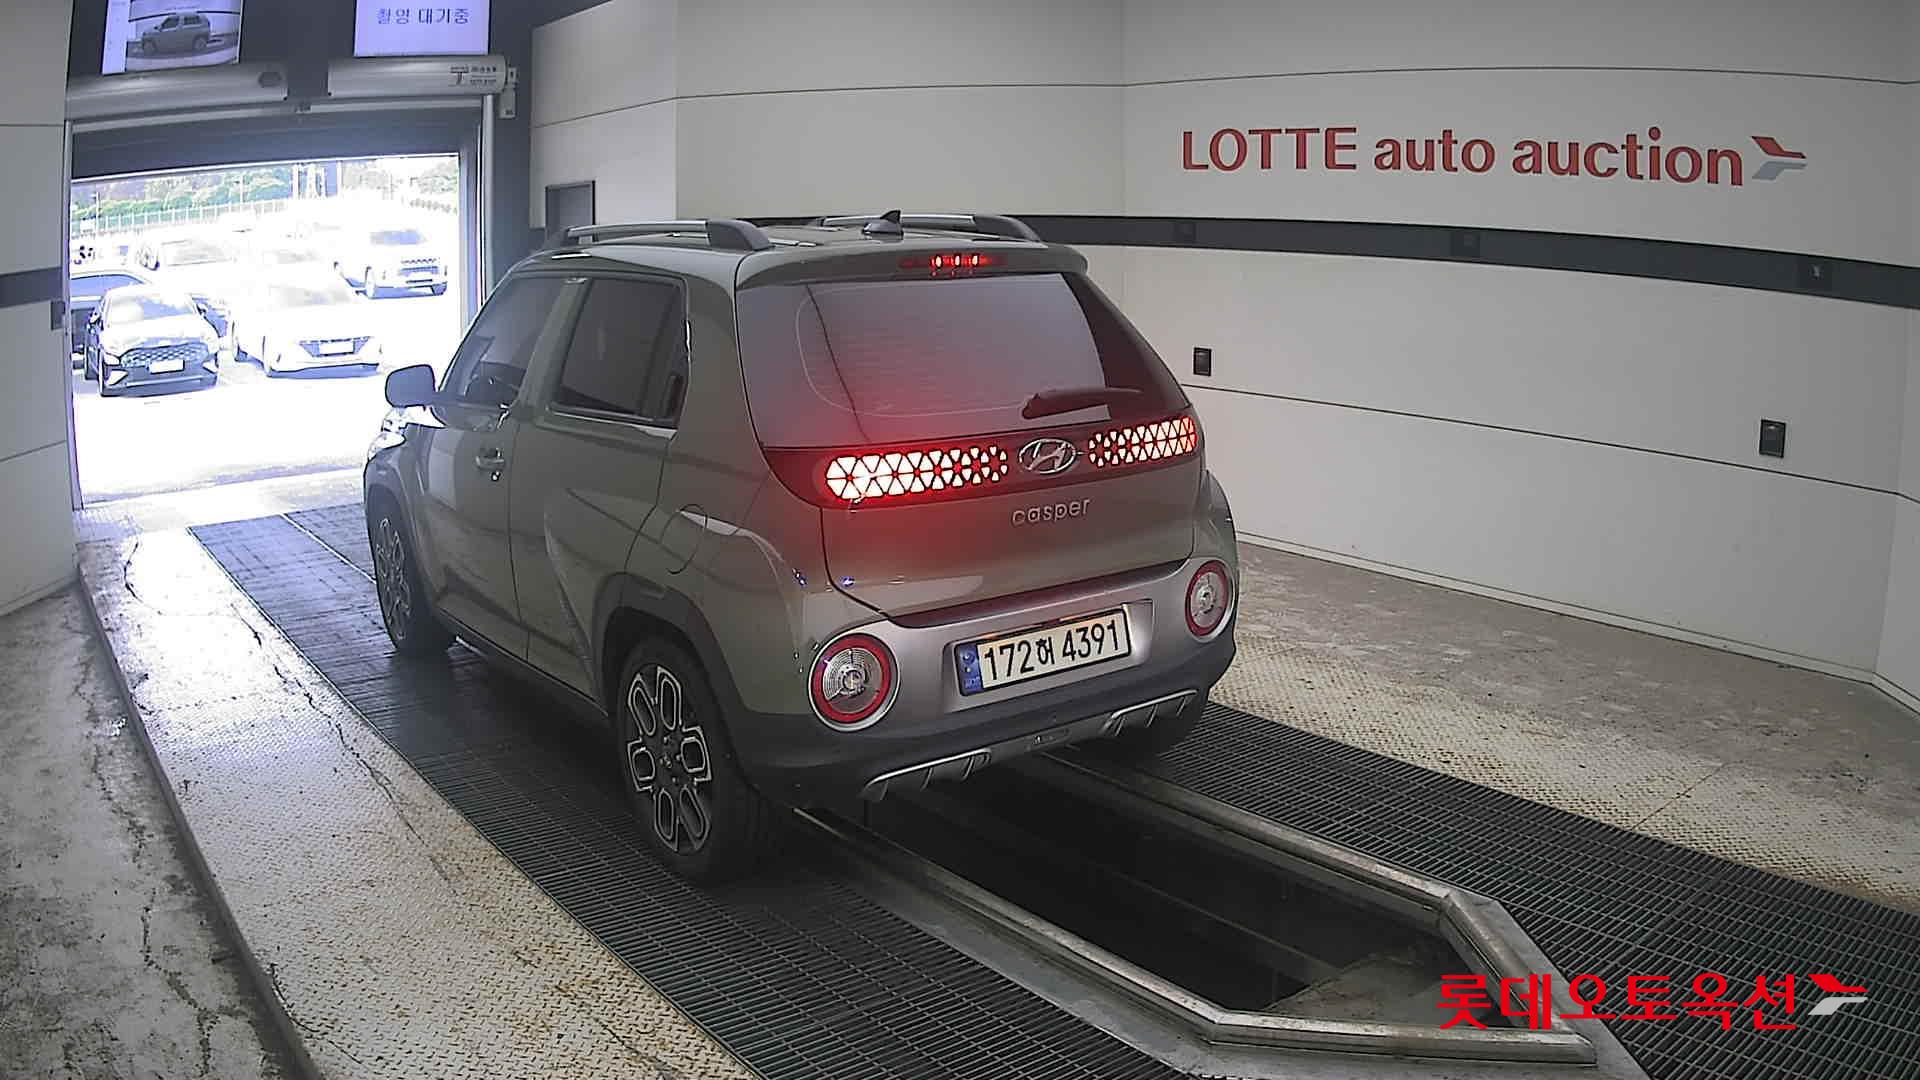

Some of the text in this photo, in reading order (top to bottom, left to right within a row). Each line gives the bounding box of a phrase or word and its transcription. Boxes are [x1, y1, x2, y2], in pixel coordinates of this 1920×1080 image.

[418, 8, 469, 24] 대기중
[1183, 127, 1743, 186] LOTTE auto auction
[1012, 499, 1090, 525] casper
[984, 619, 1119, 680] 172허 4391
